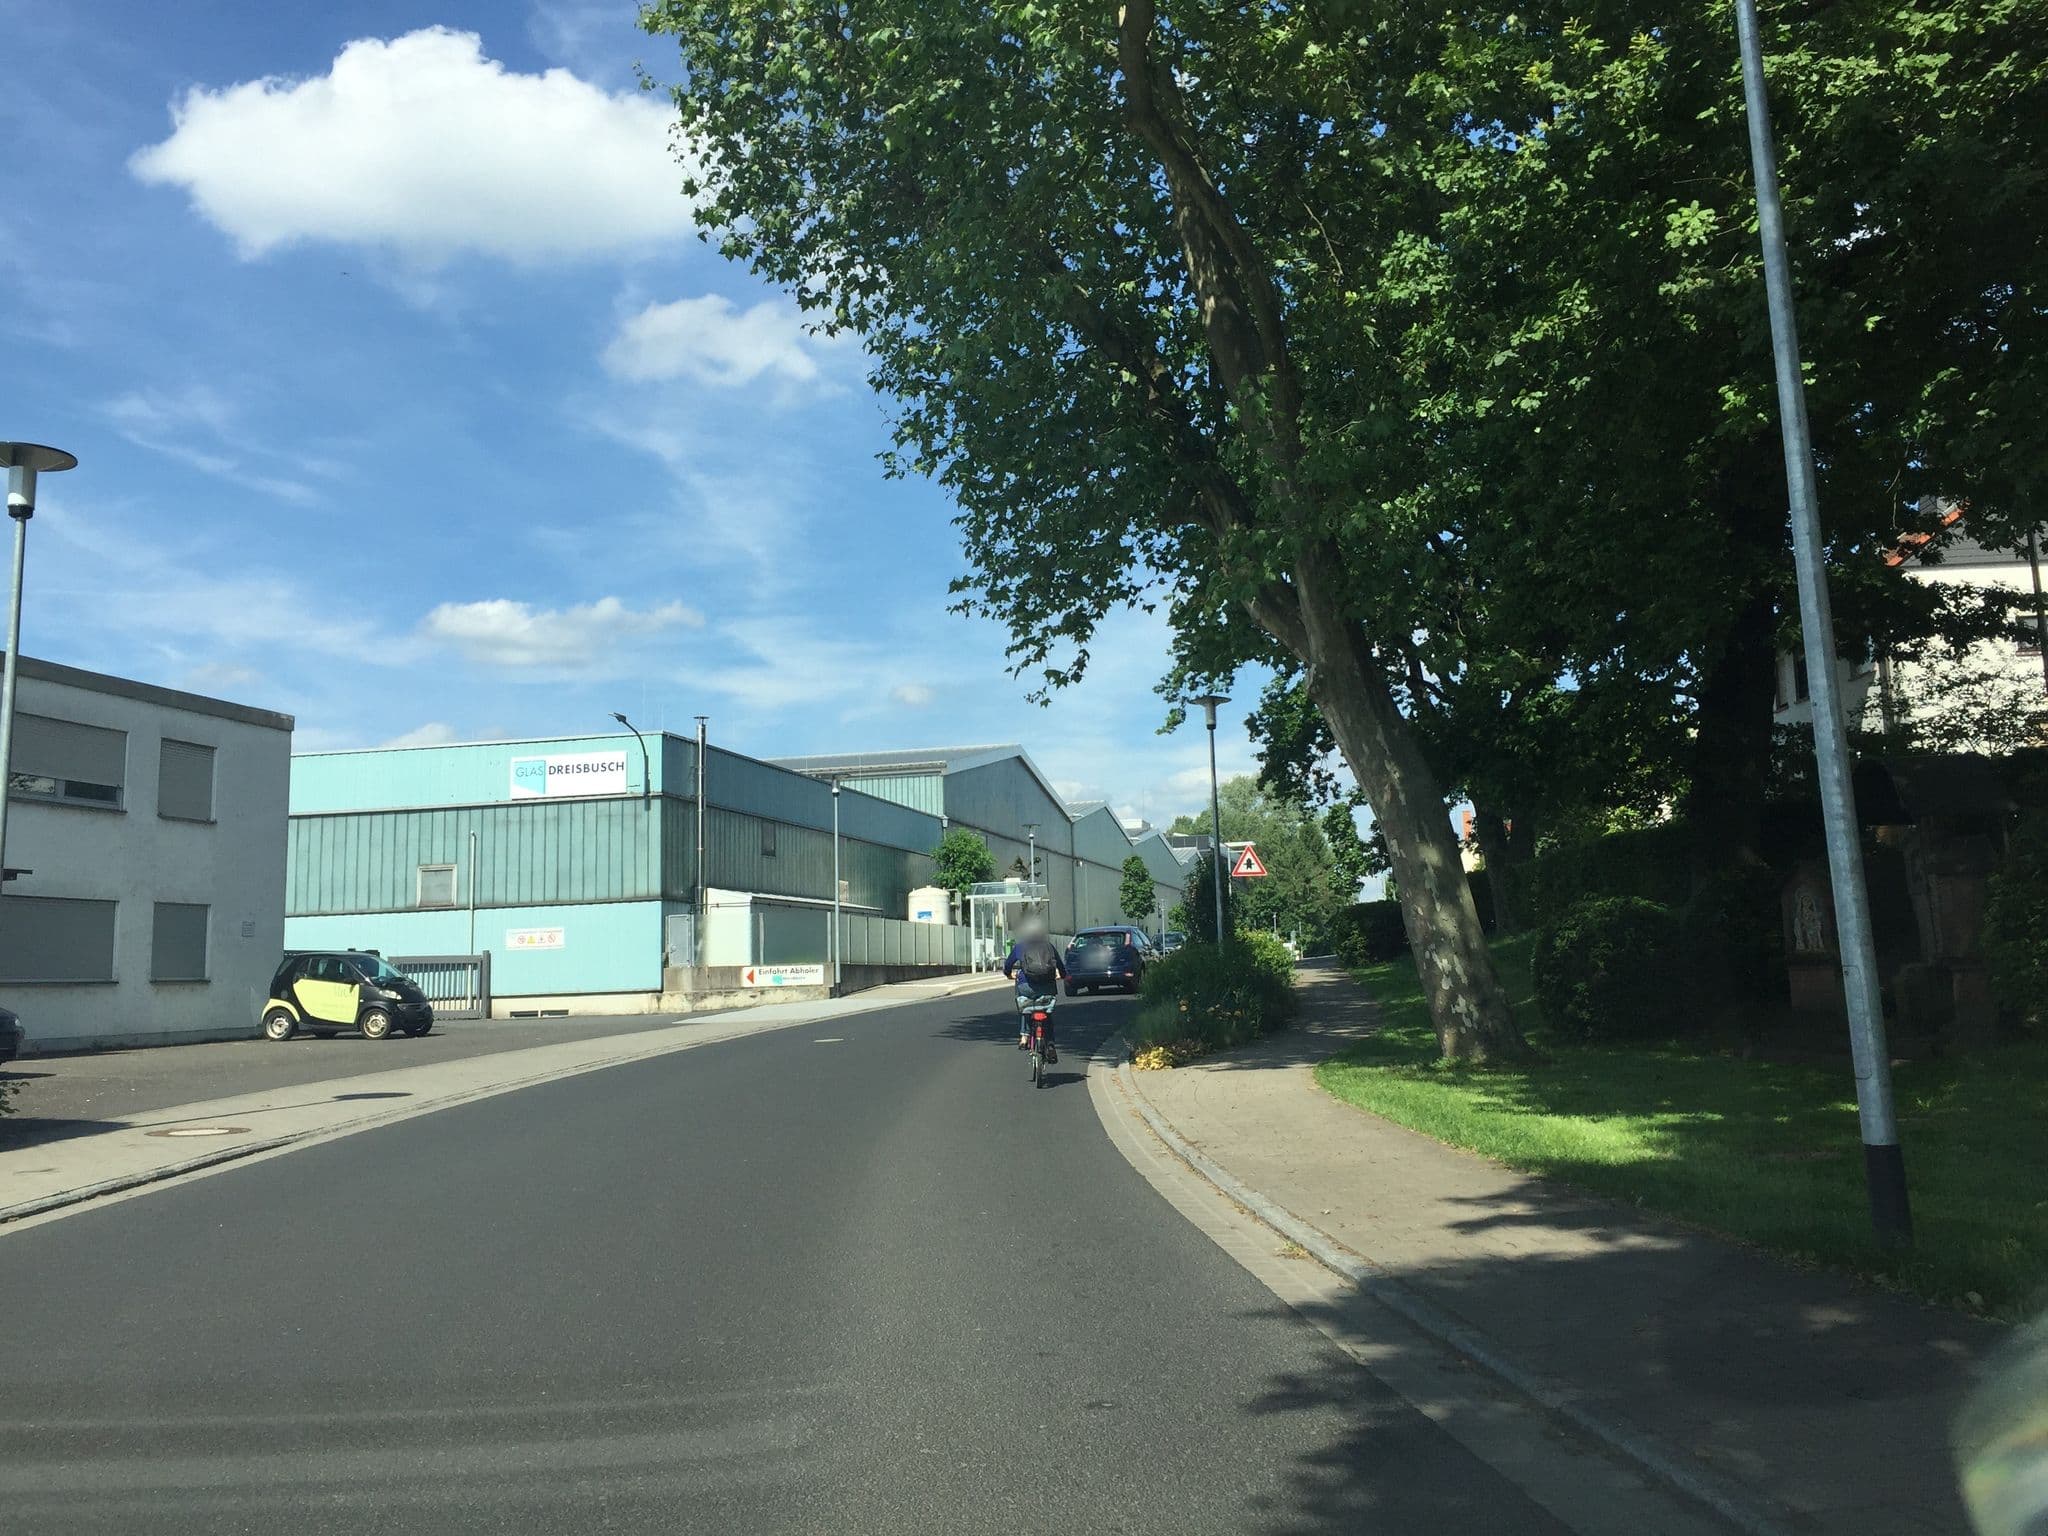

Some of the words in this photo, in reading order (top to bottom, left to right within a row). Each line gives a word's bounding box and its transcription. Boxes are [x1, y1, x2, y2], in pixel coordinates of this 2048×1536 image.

[516, 766, 544, 778] GLAS
[549, 761, 625, 775] DREISBUSCH
[758, 967, 788, 976] Einfahrt
